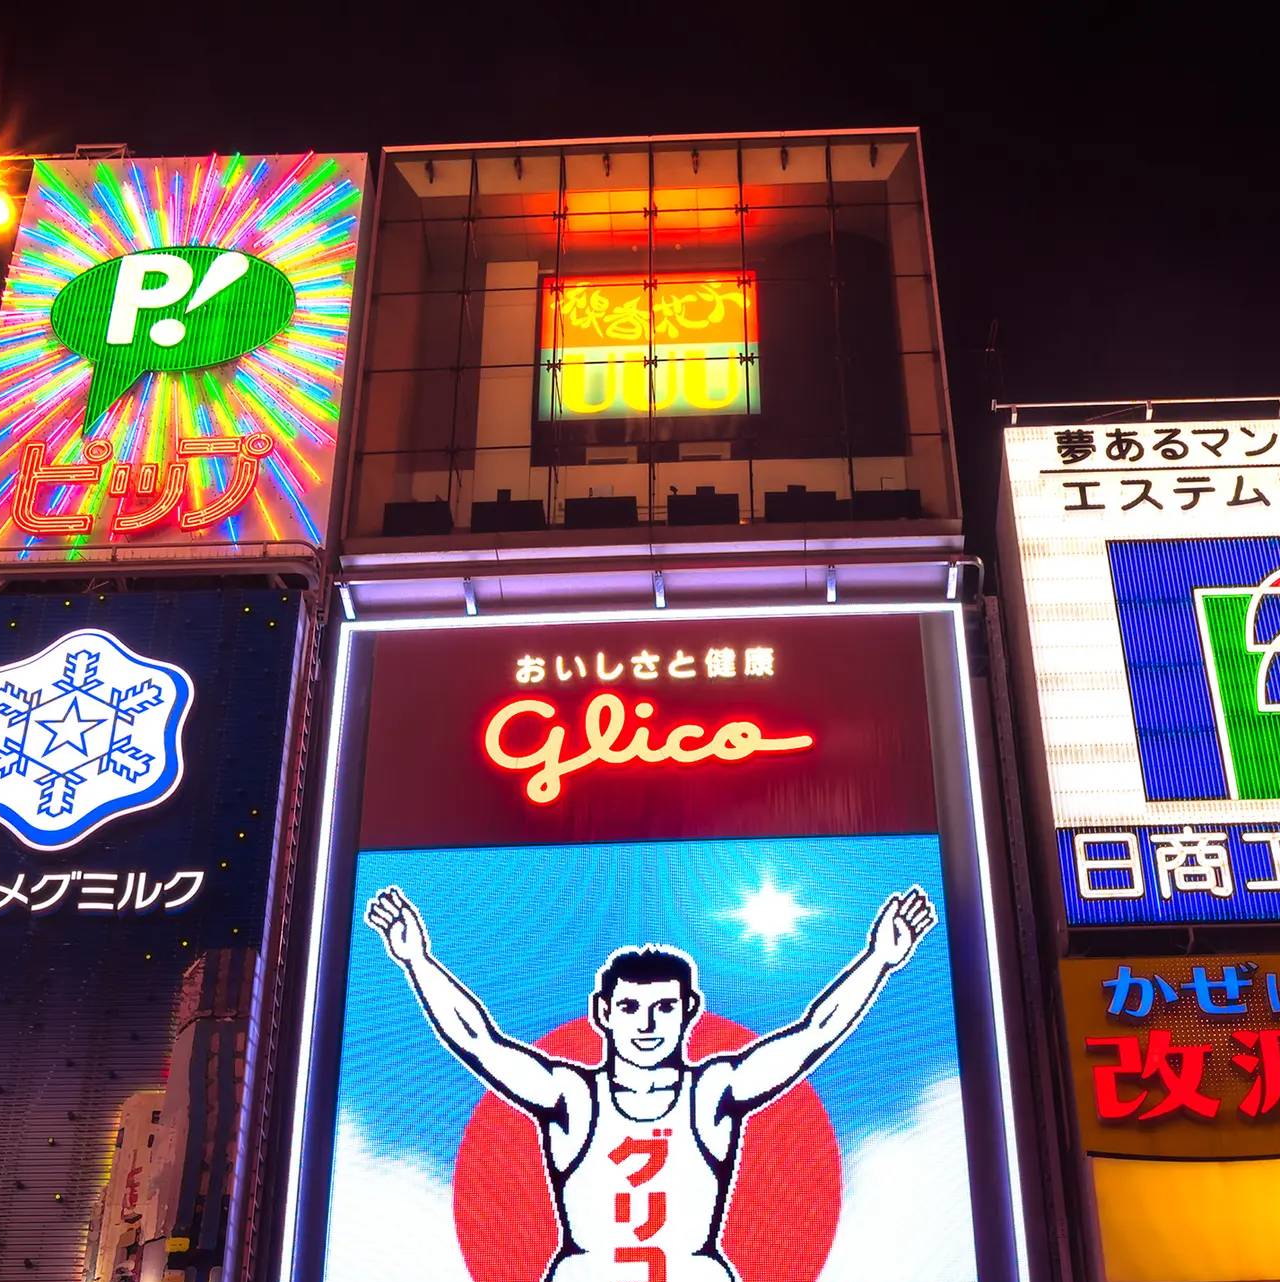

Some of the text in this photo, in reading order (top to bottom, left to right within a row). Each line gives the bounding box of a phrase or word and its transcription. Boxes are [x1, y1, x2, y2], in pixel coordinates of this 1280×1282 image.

[11, 431, 274, 534] ピップ
[516, 646, 775, 684] おいしさと健康
[485, 693, 813, 803] Glico
